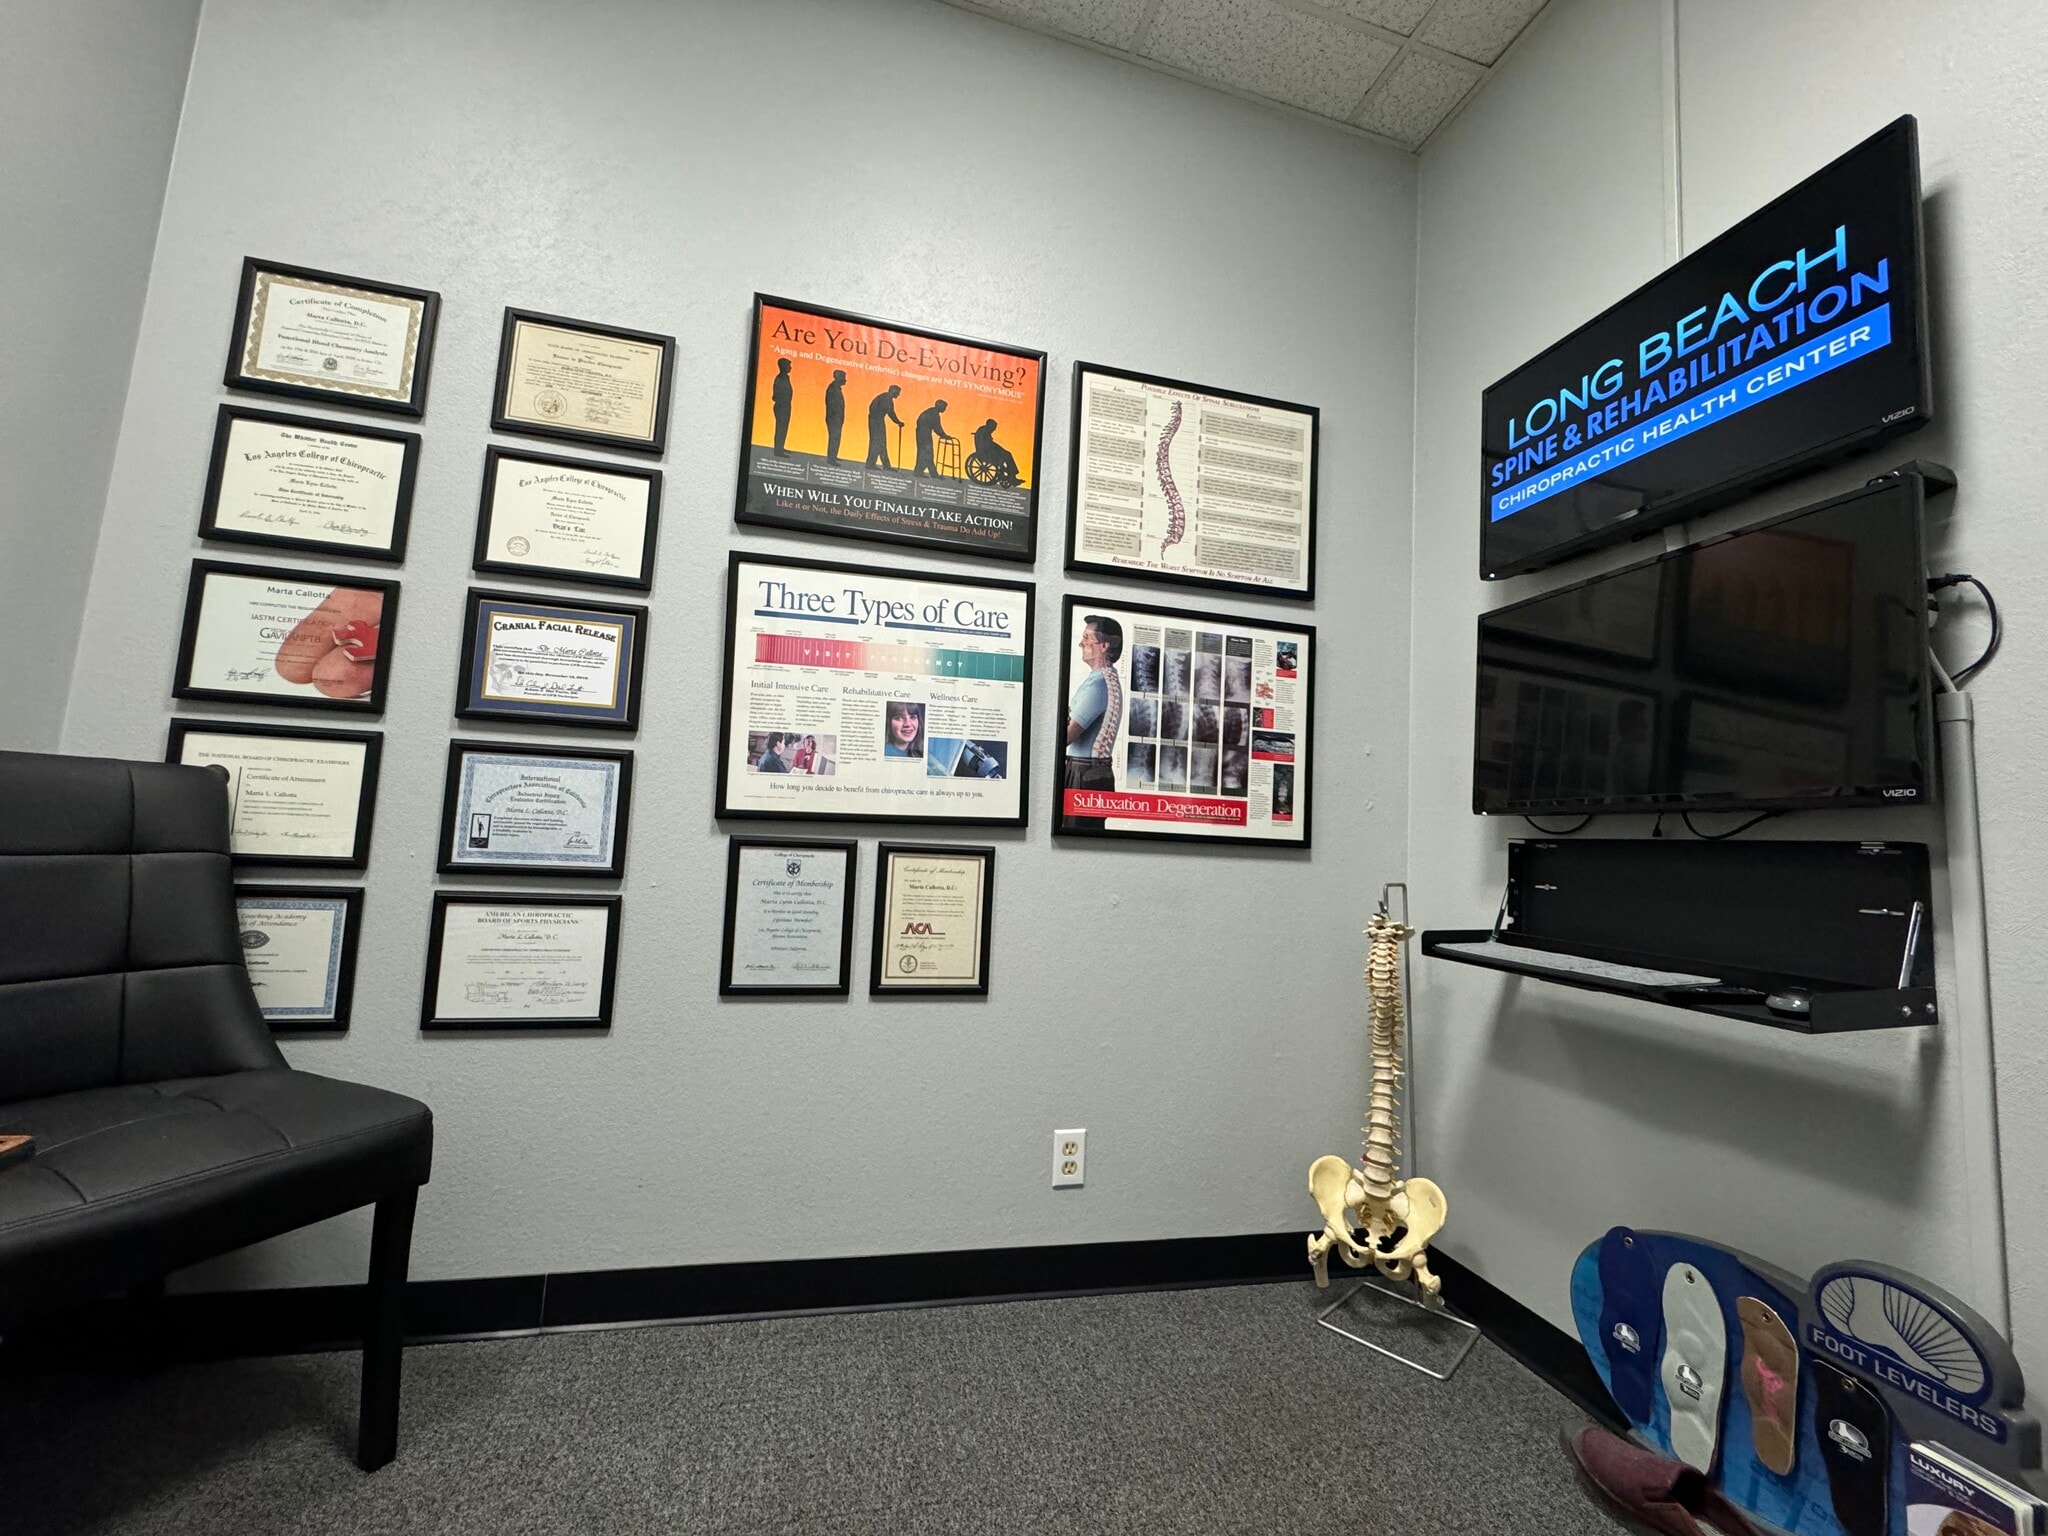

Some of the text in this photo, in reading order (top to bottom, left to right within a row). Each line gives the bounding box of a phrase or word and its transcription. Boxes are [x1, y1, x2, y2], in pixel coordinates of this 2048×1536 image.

[290, 298, 332, 306] Certificate
[344, 303, 387, 322] Completion
[278, 334, 311, 343] Functional
[331, 343, 362, 352] Chemistry
[363, 348, 388, 356] Analysis
[1509, 224, 1846, 449] LONG BEACH
[772, 320, 1027, 388] Are You De-Evolving?
[799, 350, 813, 359] and
[815, 354, 864, 370] Degenerative
[865, 363, 900, 377] (arthritic)
[901, 370, 930, 383] changes
[944, 377, 962, 387] NOT
[1491, 257, 1889, 488] SPINE & REHABILITATION
[1498, 326, 1872, 511] CHIROPRACTIC HEALTH CENTER
[1881, 406, 1915, 423] VIZIO
[244, 453, 262, 462] Los
[264, 451, 297, 459] Angeles
[299, 450, 329, 461] College
[340, 457, 387, 480] Chiropractic
[534, 476, 558, 484] Angeles
[560, 475, 582, 483] College
[591, 480, 626, 501] Chiropractic
[763, 483, 1013, 530] WHEN WILL YOU FINALLY TAKE ACTION!
[776, 500, 793, 509] Like
[794, 501, 800, 510] it
[812, 505, 829, 515] Not,
[830, 507, 841, 515] the
[844, 508, 864, 520] Daily
[866, 511, 890, 523] Effects
[892, 516, 900, 524] of
[901, 517, 922, 527] Stress
[924, 520, 929, 528] &
[932, 520, 958, 531] Trauma
[960, 525, 970, 533] Do
[972, 526, 986, 535] Add
[987, 530, 1001, 539] Up!
[267, 586, 331, 599] Marta Callotta
[759, 581, 1009, 629] Three Types of Care
[251, 613, 275, 622] IASTM
[494, 621, 616, 642] CRANIAL FACIAL RELEASE
[804, 649, 851, 659] VISIT
[751, 680, 829, 692] Initial Intensive Care
[843, 687, 911, 698] Rehabilitative Care
[930, 693, 978, 703] Wellness Care
[520, 774, 561, 782] International
[787, 783, 800, 791] long
[802, 784, 813, 792] you
[815, 784, 834, 792] decide
[936, 789, 955, 797] always
[1883, 788, 1917, 797] VIZIO
[1073, 793, 1241, 817] Subluxation Degeneration
[752, 879, 786, 888] Certificate
[796, 881, 833, 889] Membership
[901, 923, 933, 935] ACA
[1812, 1327, 1998, 1436] FOOT LEVELERS
[1910, 1454, 1975, 1496] LUXURY
